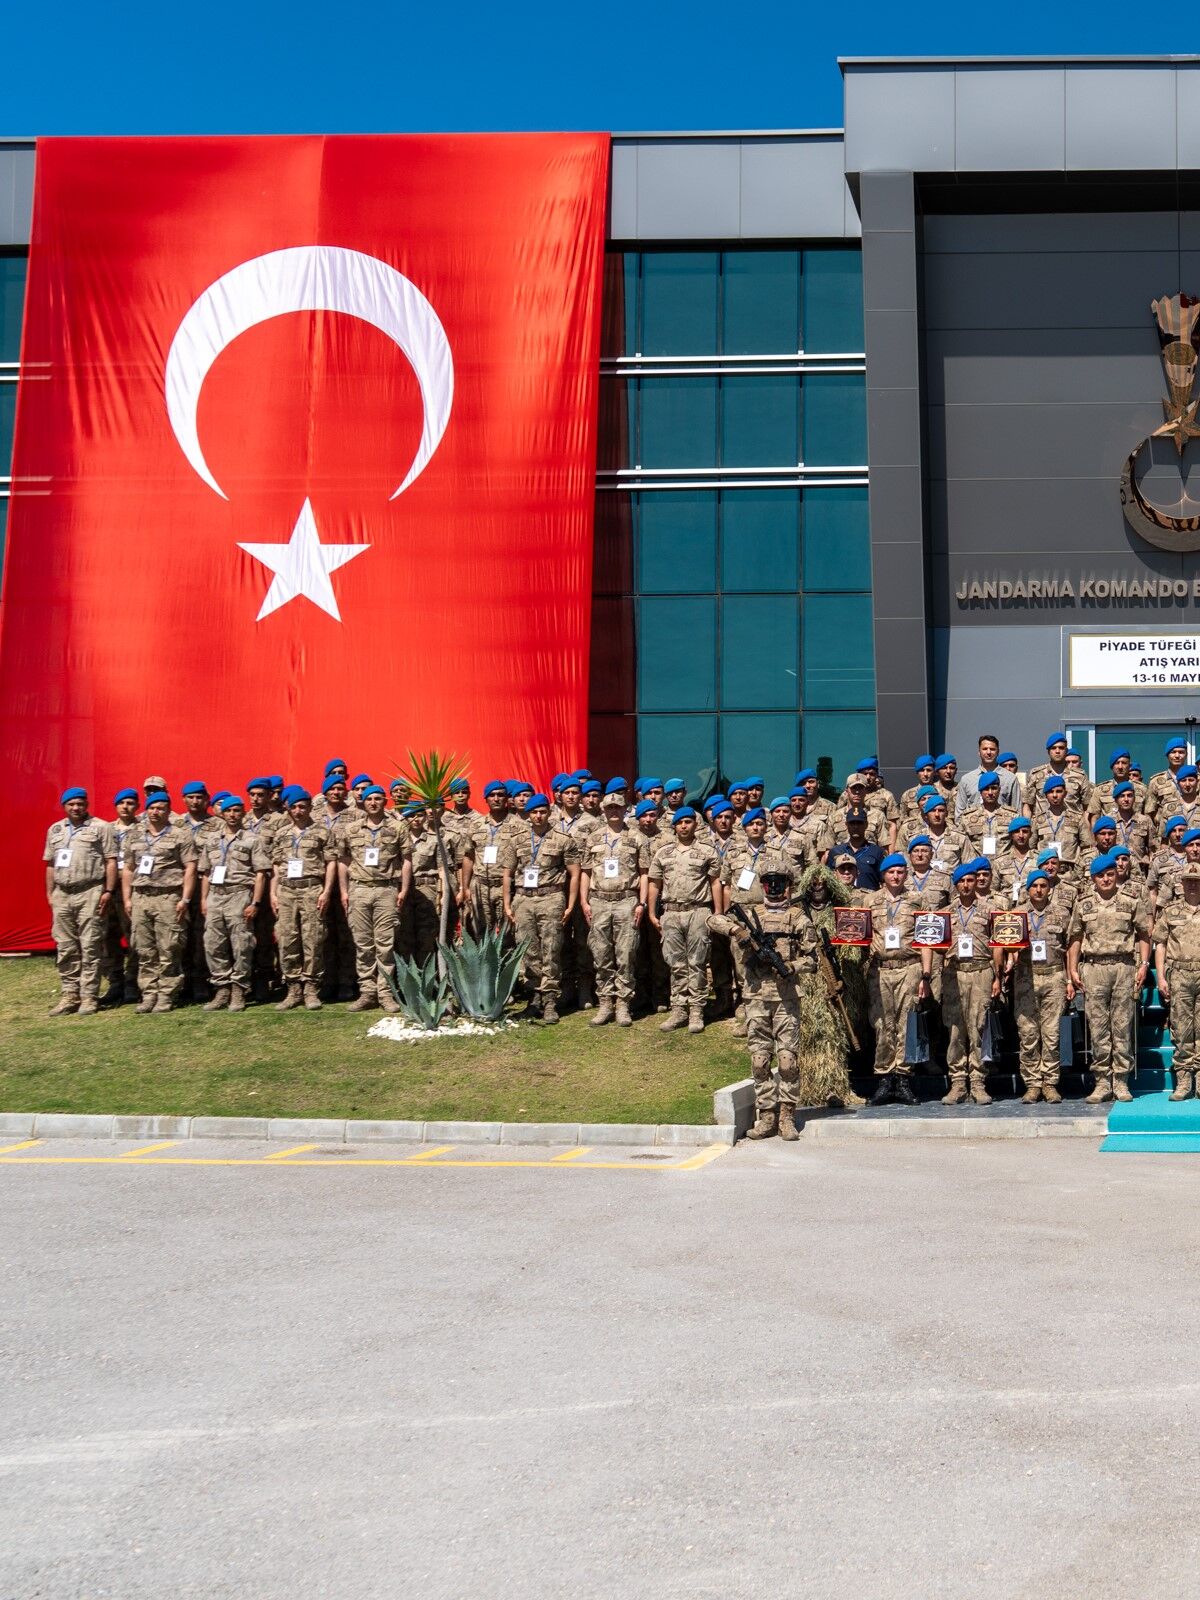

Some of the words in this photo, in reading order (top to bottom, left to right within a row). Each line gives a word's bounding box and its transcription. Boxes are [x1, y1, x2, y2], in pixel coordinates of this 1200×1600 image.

[956, 580, 1075, 599] JANDARMA
[1080, 579, 1188, 597] KOMANDO
[1100, 639, 1145, 651] PİYADE
[1150, 639, 1196, 651] TÜFEĞİ
[1139, 657, 1168, 669] ATIŞ
[1132, 673, 1166, 683] 13-16
